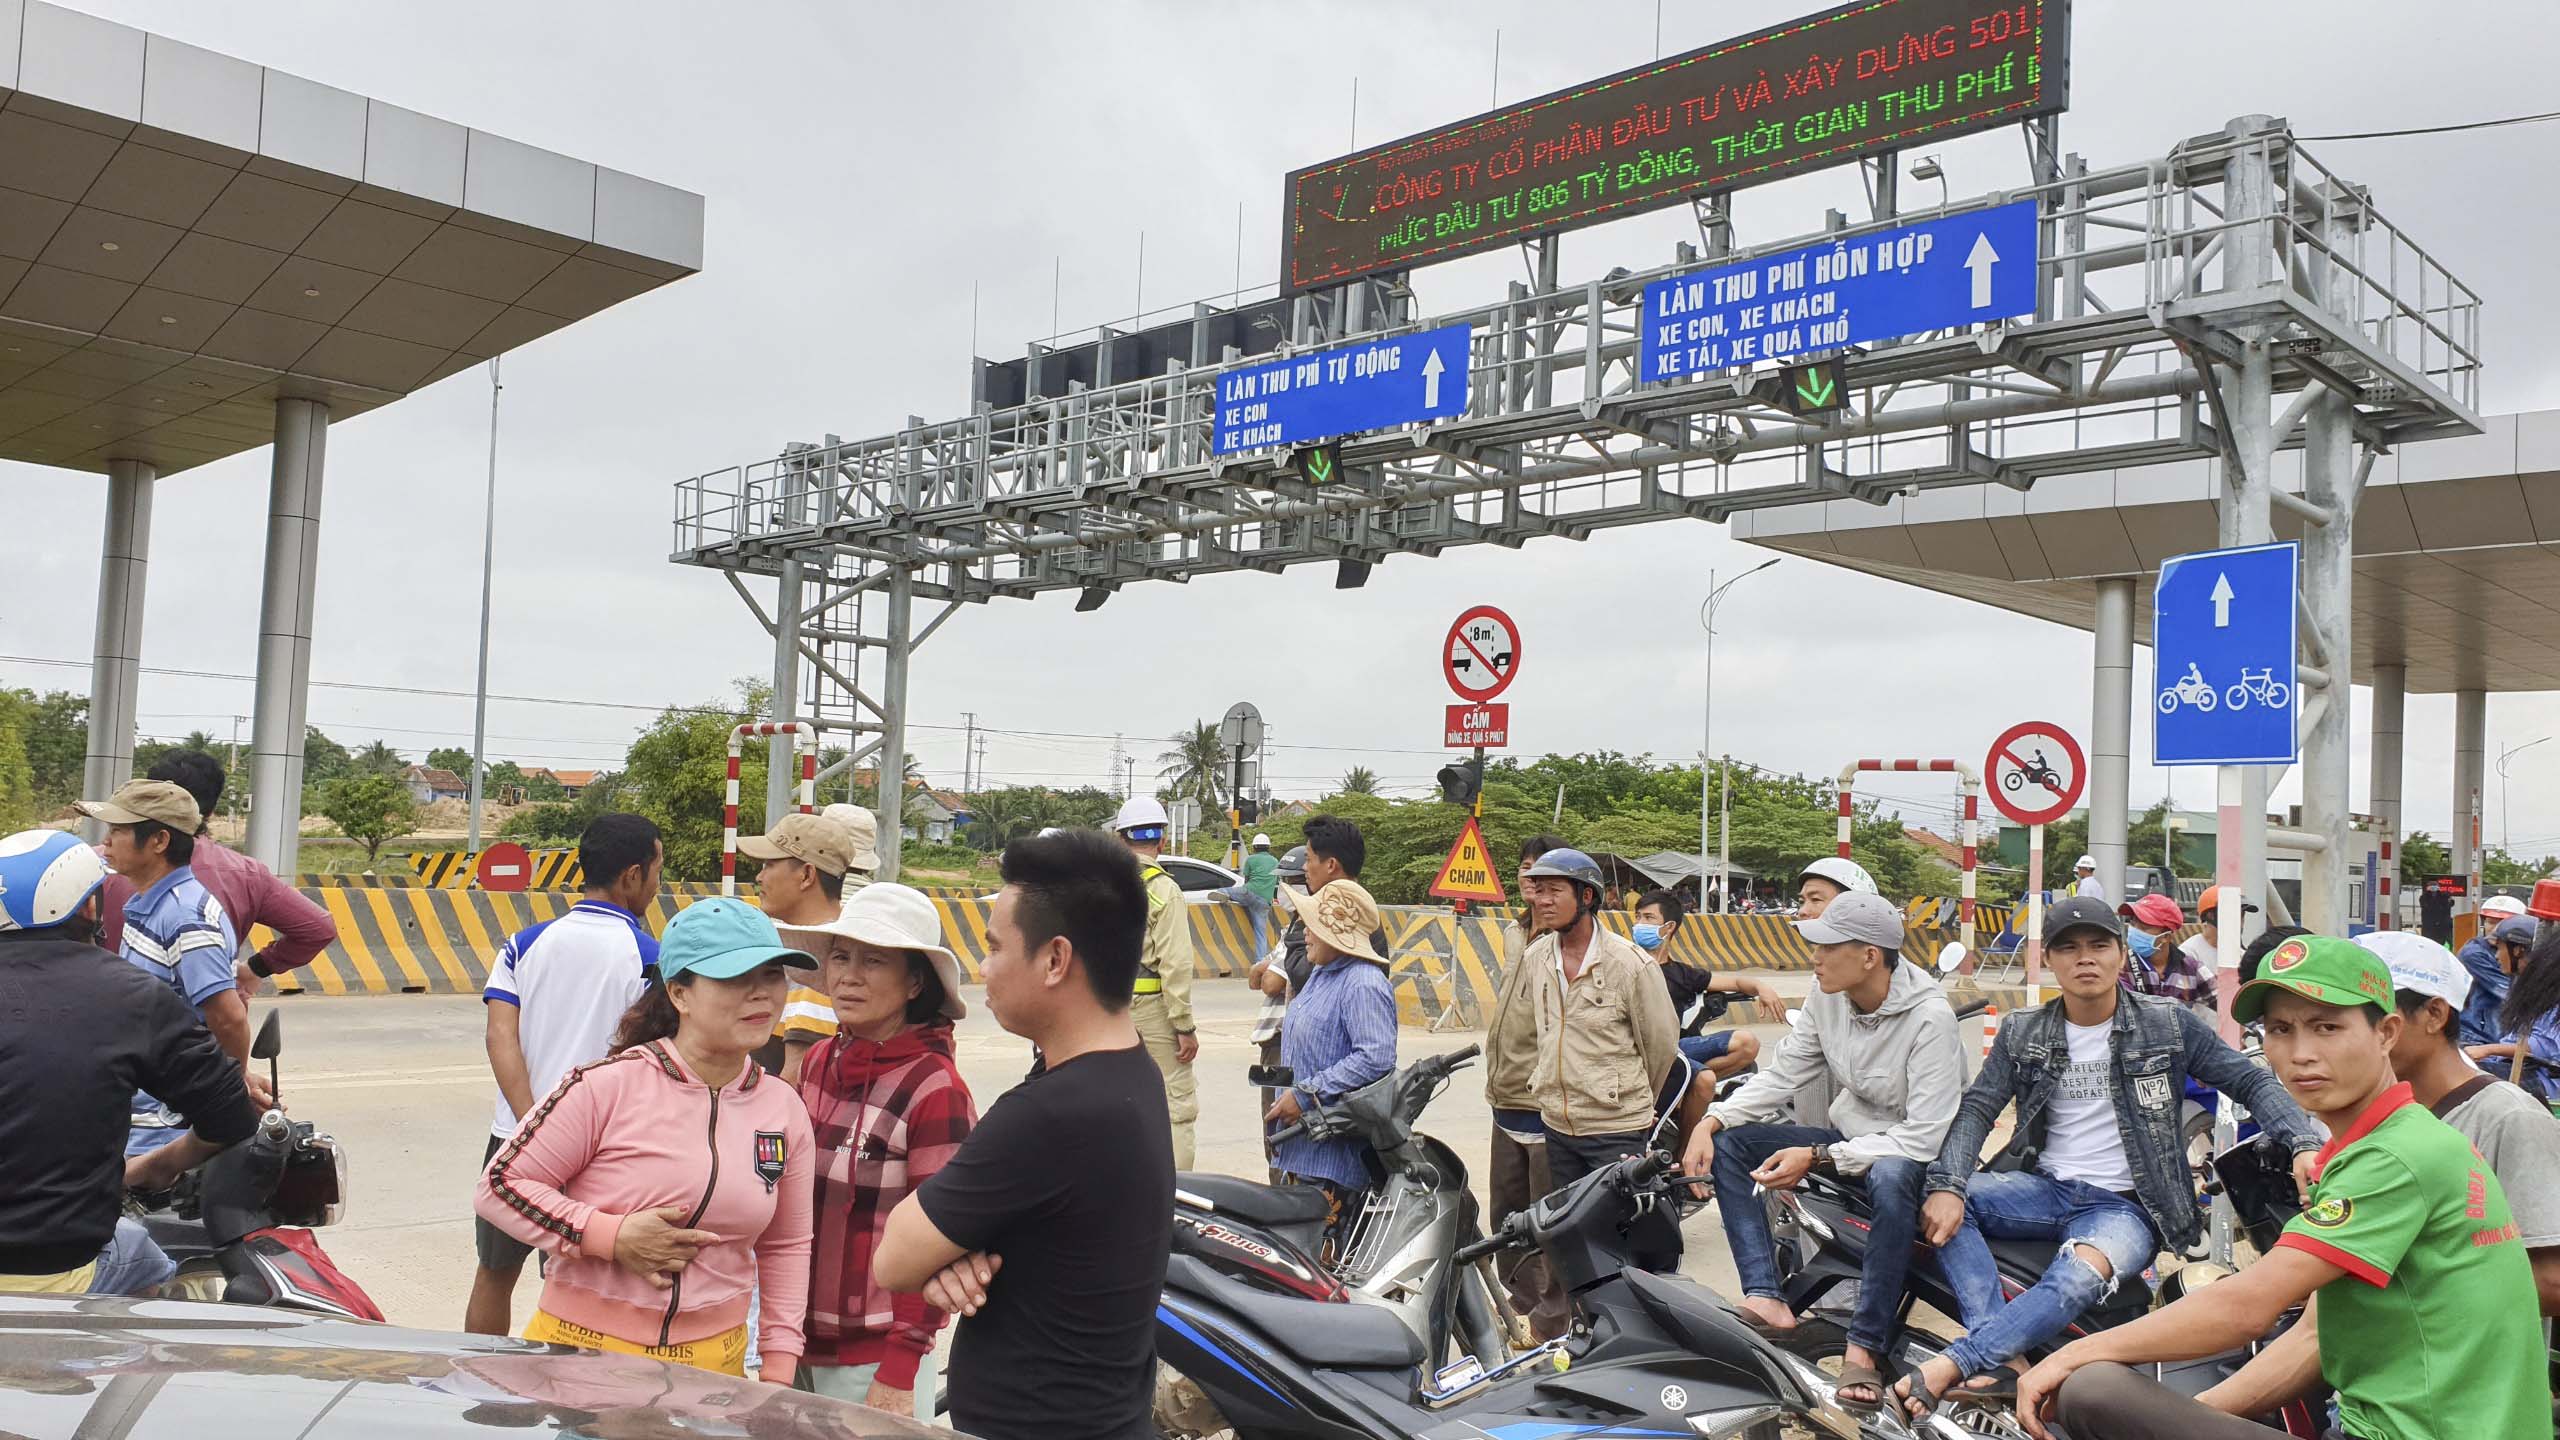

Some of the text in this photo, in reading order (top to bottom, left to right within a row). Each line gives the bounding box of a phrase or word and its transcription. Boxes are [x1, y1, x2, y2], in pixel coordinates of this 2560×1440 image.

[1376, 169, 1444, 212] CÔNG
[1450, 160, 1480, 192] TY
[1680, 84, 1726, 126] TƯ
[1732, 69, 1774, 112] VÀ
[1783, 54, 1844, 100] XÂY
[1857, 25, 1957, 80] DỰNG
[1969, 5, 2031, 48] 501
[1487, 187, 1523, 222] TƯ
[1528, 178, 1569, 213] 806
[1711, 119, 1784, 164] THỜI
[1794, 101, 1867, 143] GIAN
[1878, 79, 1944, 121] THU
[1956, 50, 2015, 103] PHÍ
[1659, 231, 1933, 317] LÀN THU PHÍ HỖN HỢP
[1658, 291, 1835, 347] XE CON, XE KHÁCH
[1657, 309, 1849, 376] XE TẢI, XE QUÁ KHỔ
[1225, 346, 1401, 403] LÀN THU PHÍ TỰ ĐỘNG
[1224, 402, 1268, 428] XE CON
[1223, 422, 1282, 450] XE KHÁCH
[1473, 626, 1490, 641] 8m
[1463, 705, 1490, 729] CẤM
[1464, 731, 1471, 744] XE
[1472, 728, 1484, 746] QUÁ
[1490, 728, 1504, 743] PHÚT
[1463, 845, 1475, 860] ĐI
[1449, 866, 1486, 887] CHẬM
[2061, 1075, 2109, 1087] BEST OF
[645, 1343, 694, 1358] RUBIS
